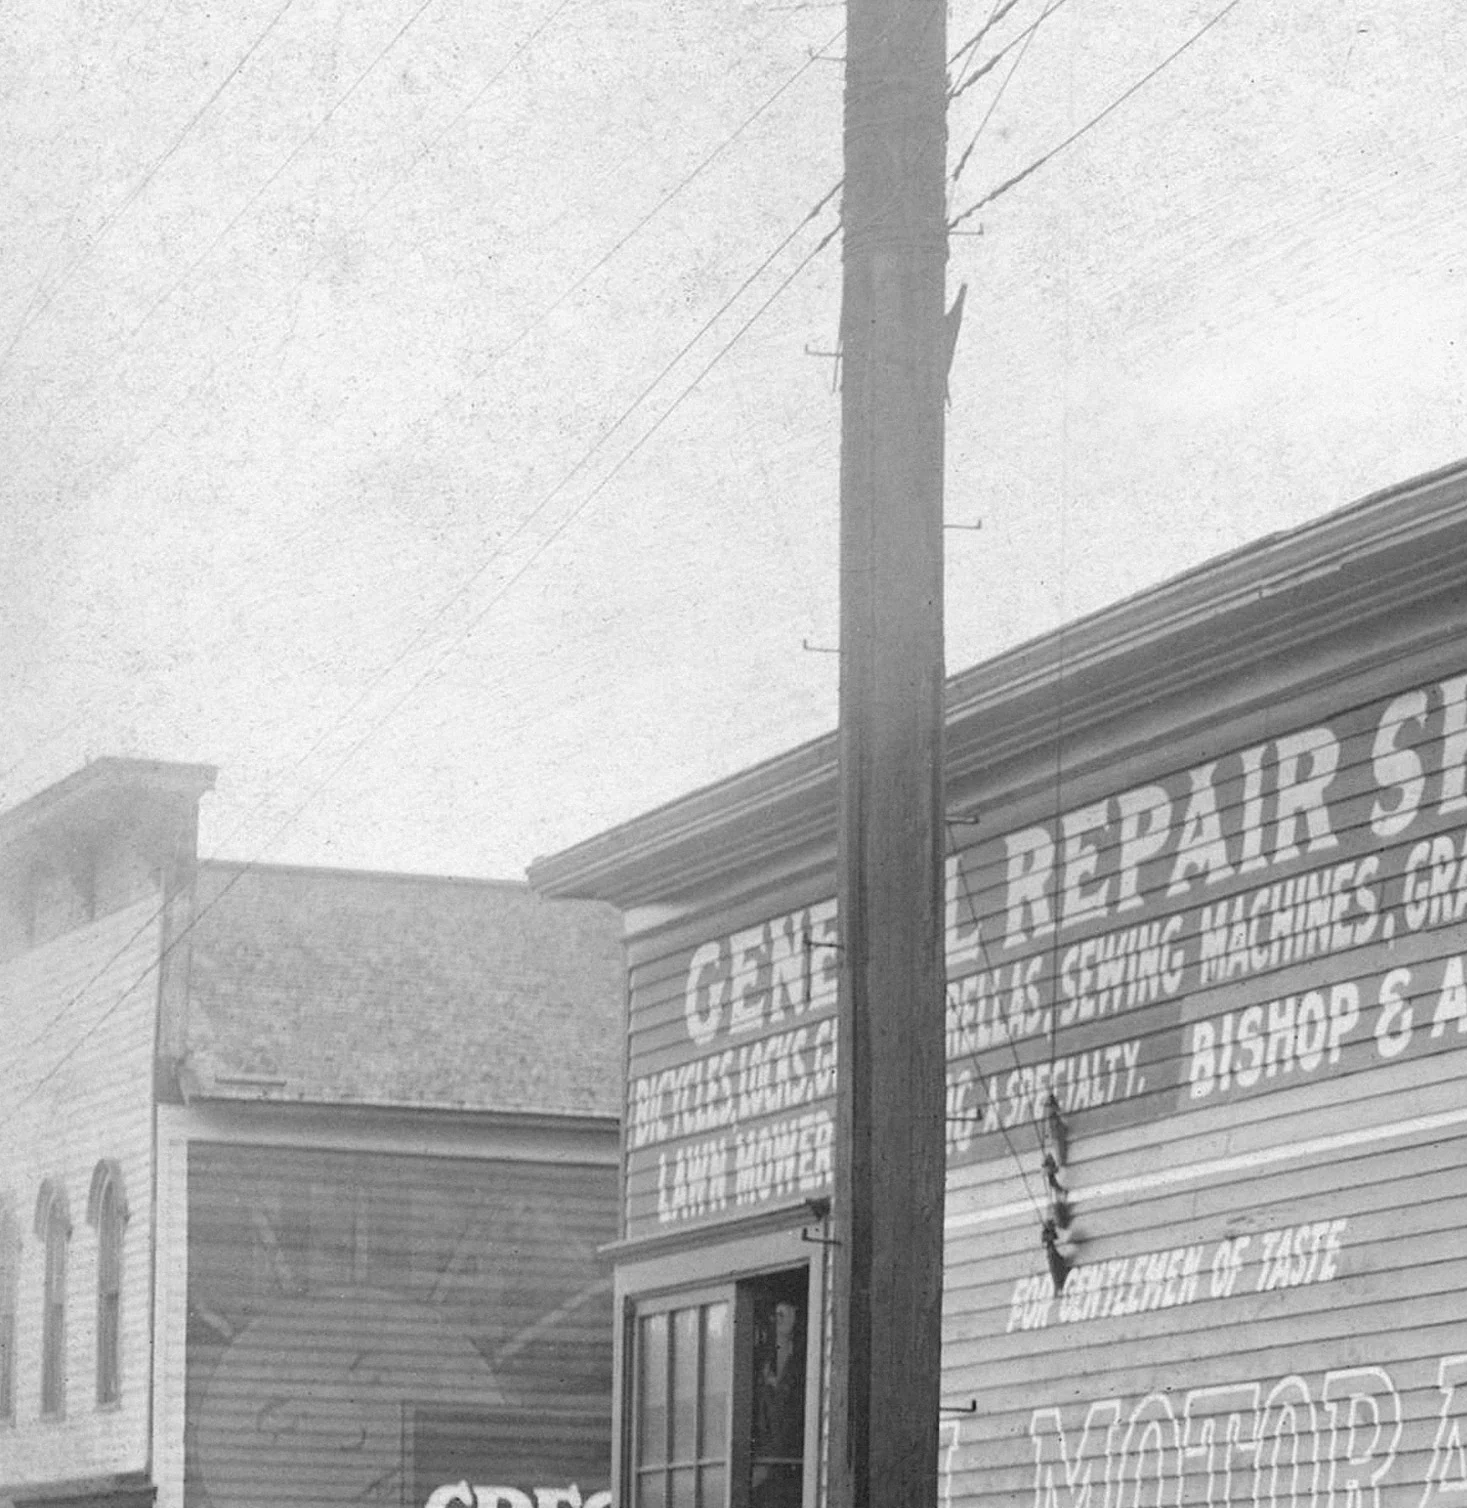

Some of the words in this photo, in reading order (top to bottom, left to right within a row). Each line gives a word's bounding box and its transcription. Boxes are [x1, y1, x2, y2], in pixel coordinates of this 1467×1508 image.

[1003, 727, 1340, 949] REPAIR
[1060, 914, 1184, 1026] SEWING
[1200, 855, 1396, 985] MACHINES,
[1188, 980, 1361, 1100] BISHOP
[1373, 967, 1414, 1059] &
[658, 1136, 728, 1224] LAWN
[1005, 1272, 1053, 1334] FOR
[1058, 1245, 1205, 1323] GENTLEMEN
[1210, 1235, 1251, 1298] OF
[1256, 1218, 1349, 1292] TASTE
